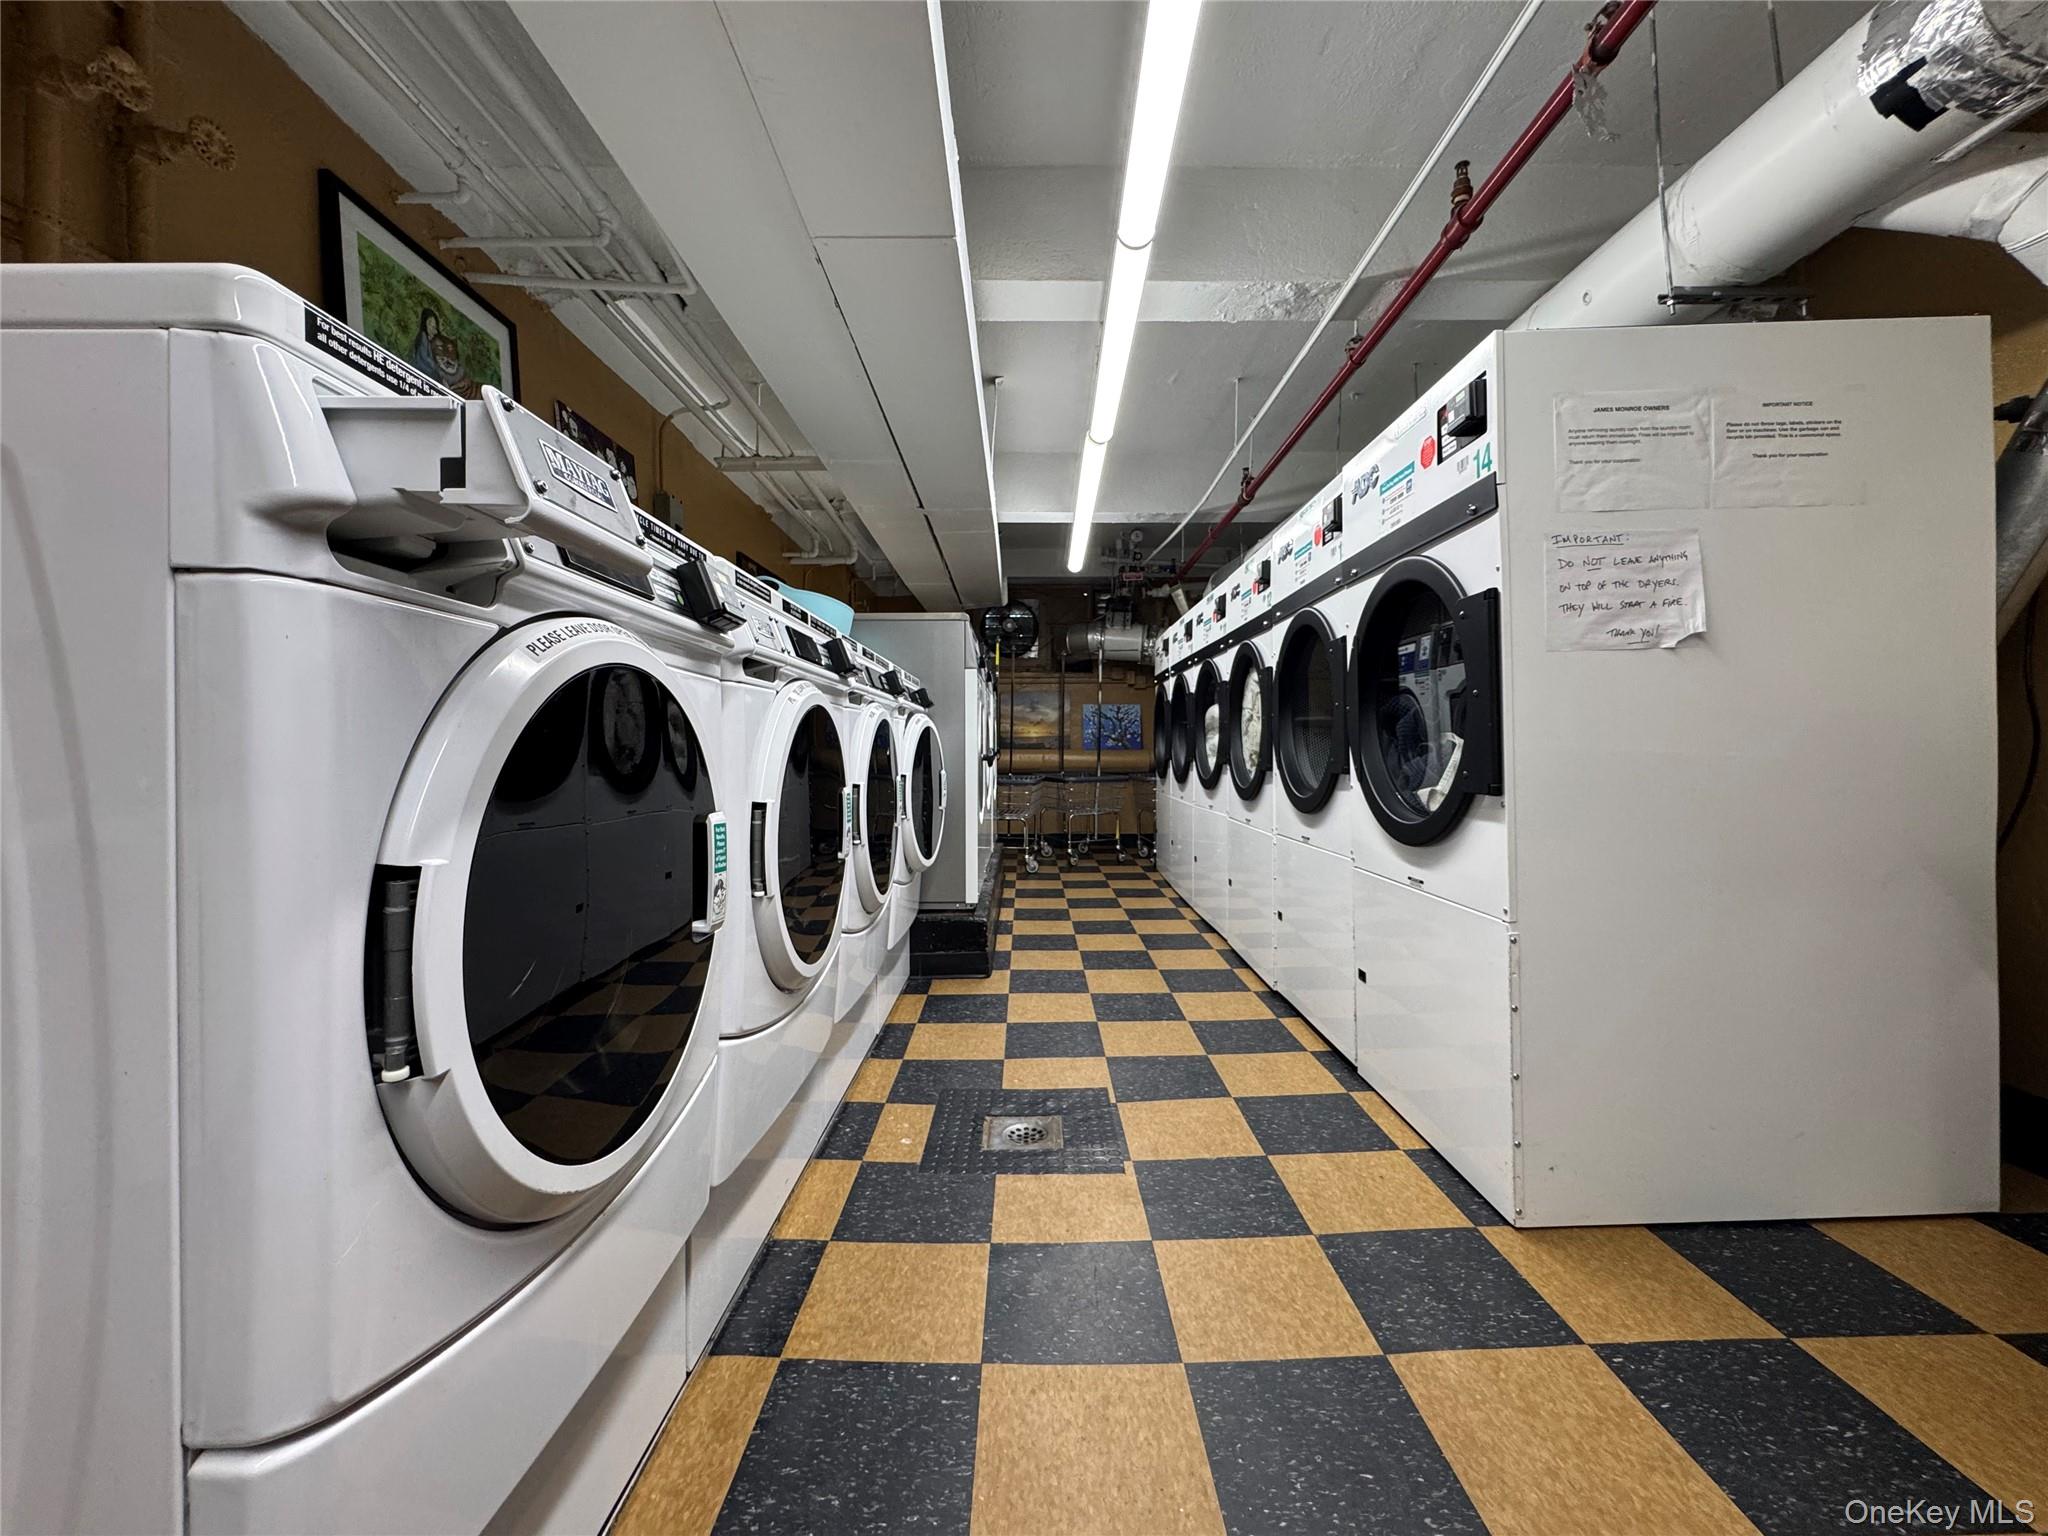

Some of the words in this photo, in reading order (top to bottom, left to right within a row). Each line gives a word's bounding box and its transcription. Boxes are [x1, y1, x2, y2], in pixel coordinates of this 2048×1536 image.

[316, 317, 329, 332] For
[331, 325, 347, 343] best
[348, 338, 372, 358] results
[373, 350, 384, 365] HE
[386, 359, 422, 389] detergent
[423, 381, 430, 394] is
[316, 332, 327, 344] all
[328, 339, 347, 356] other
[349, 350, 385, 378] detergents
[386, 374, 398, 386] use
[400, 381, 409, 393] 1/4
[544, 446, 609, 498] MAYTAG
[1473, 442, 1493, 479] 14
[650, 522, 666, 538] TIMES
[1551, 533, 1630, 545] IMPORTANT:
[1583, 556, 1607, 572] NOT
[1613, 556, 1643, 567] LEAVE
[1649, 550, 1688, 569] ANYTHING
[1559, 583, 1571, 593] ON
[1575, 580, 1591, 592] TOP
[1597, 580, 1607, 591] OF
[1612, 579, 1629, 589] THE
[1638, 579, 1679, 592] DRYERS.
[1559, 603, 1585, 618] THEY
[1592, 601, 1612, 611] WILL
[1649, 601, 1657, 609] A
[526, 629, 567, 657] PLEASE
[562, 622, 592, 639] LEAVE
